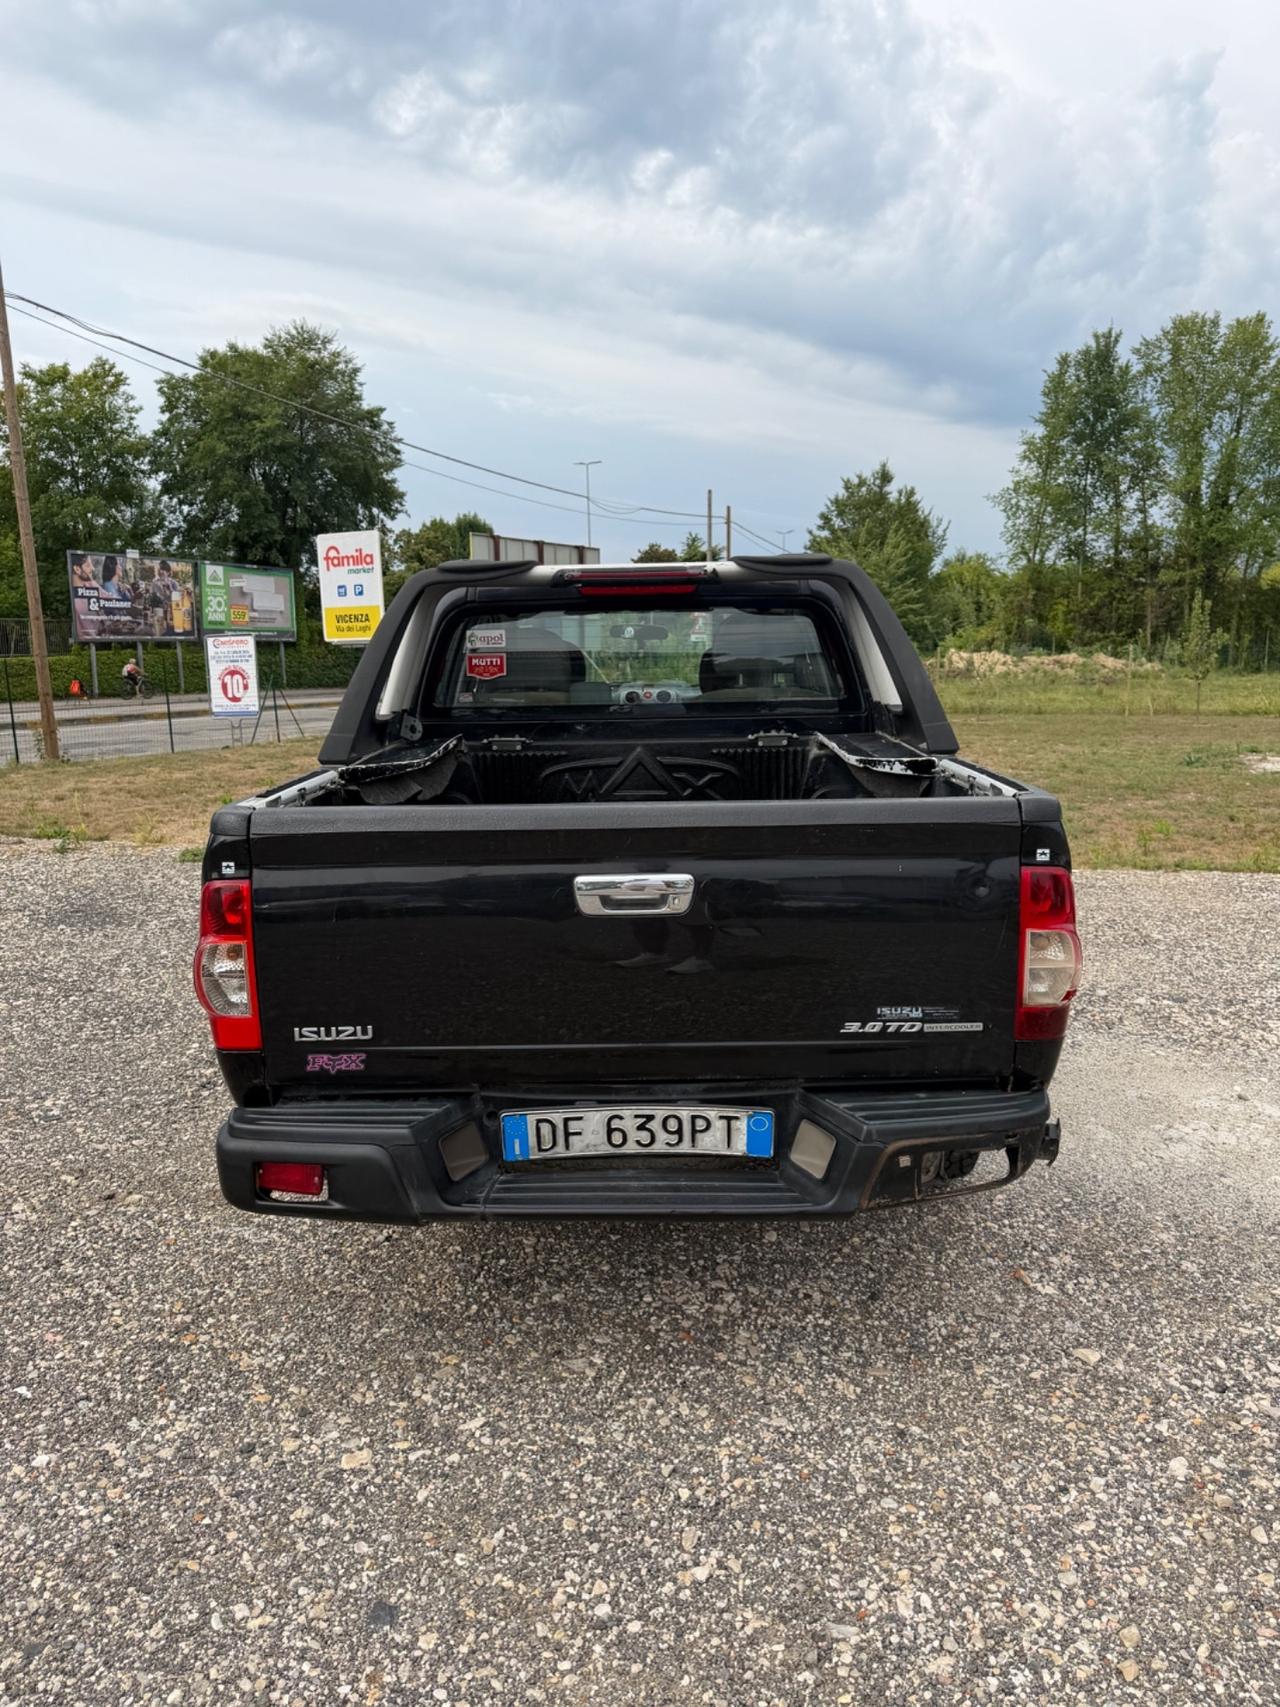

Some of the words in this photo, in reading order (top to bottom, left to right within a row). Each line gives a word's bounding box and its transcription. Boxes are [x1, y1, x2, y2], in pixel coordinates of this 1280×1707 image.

[324, 546, 374, 571] famila
[78, 587, 98, 596] Pizza
[100, 600, 131, 608] Paulaner
[208, 597, 224, 612] 30
[336, 614, 370, 624] VICENZA
[472, 658, 500, 666] MUTTI
[877, 1007, 922, 1015] ISUZU
[293, 1025, 373, 1042] ISUZU
[535, 1116, 584, 1153] DF
